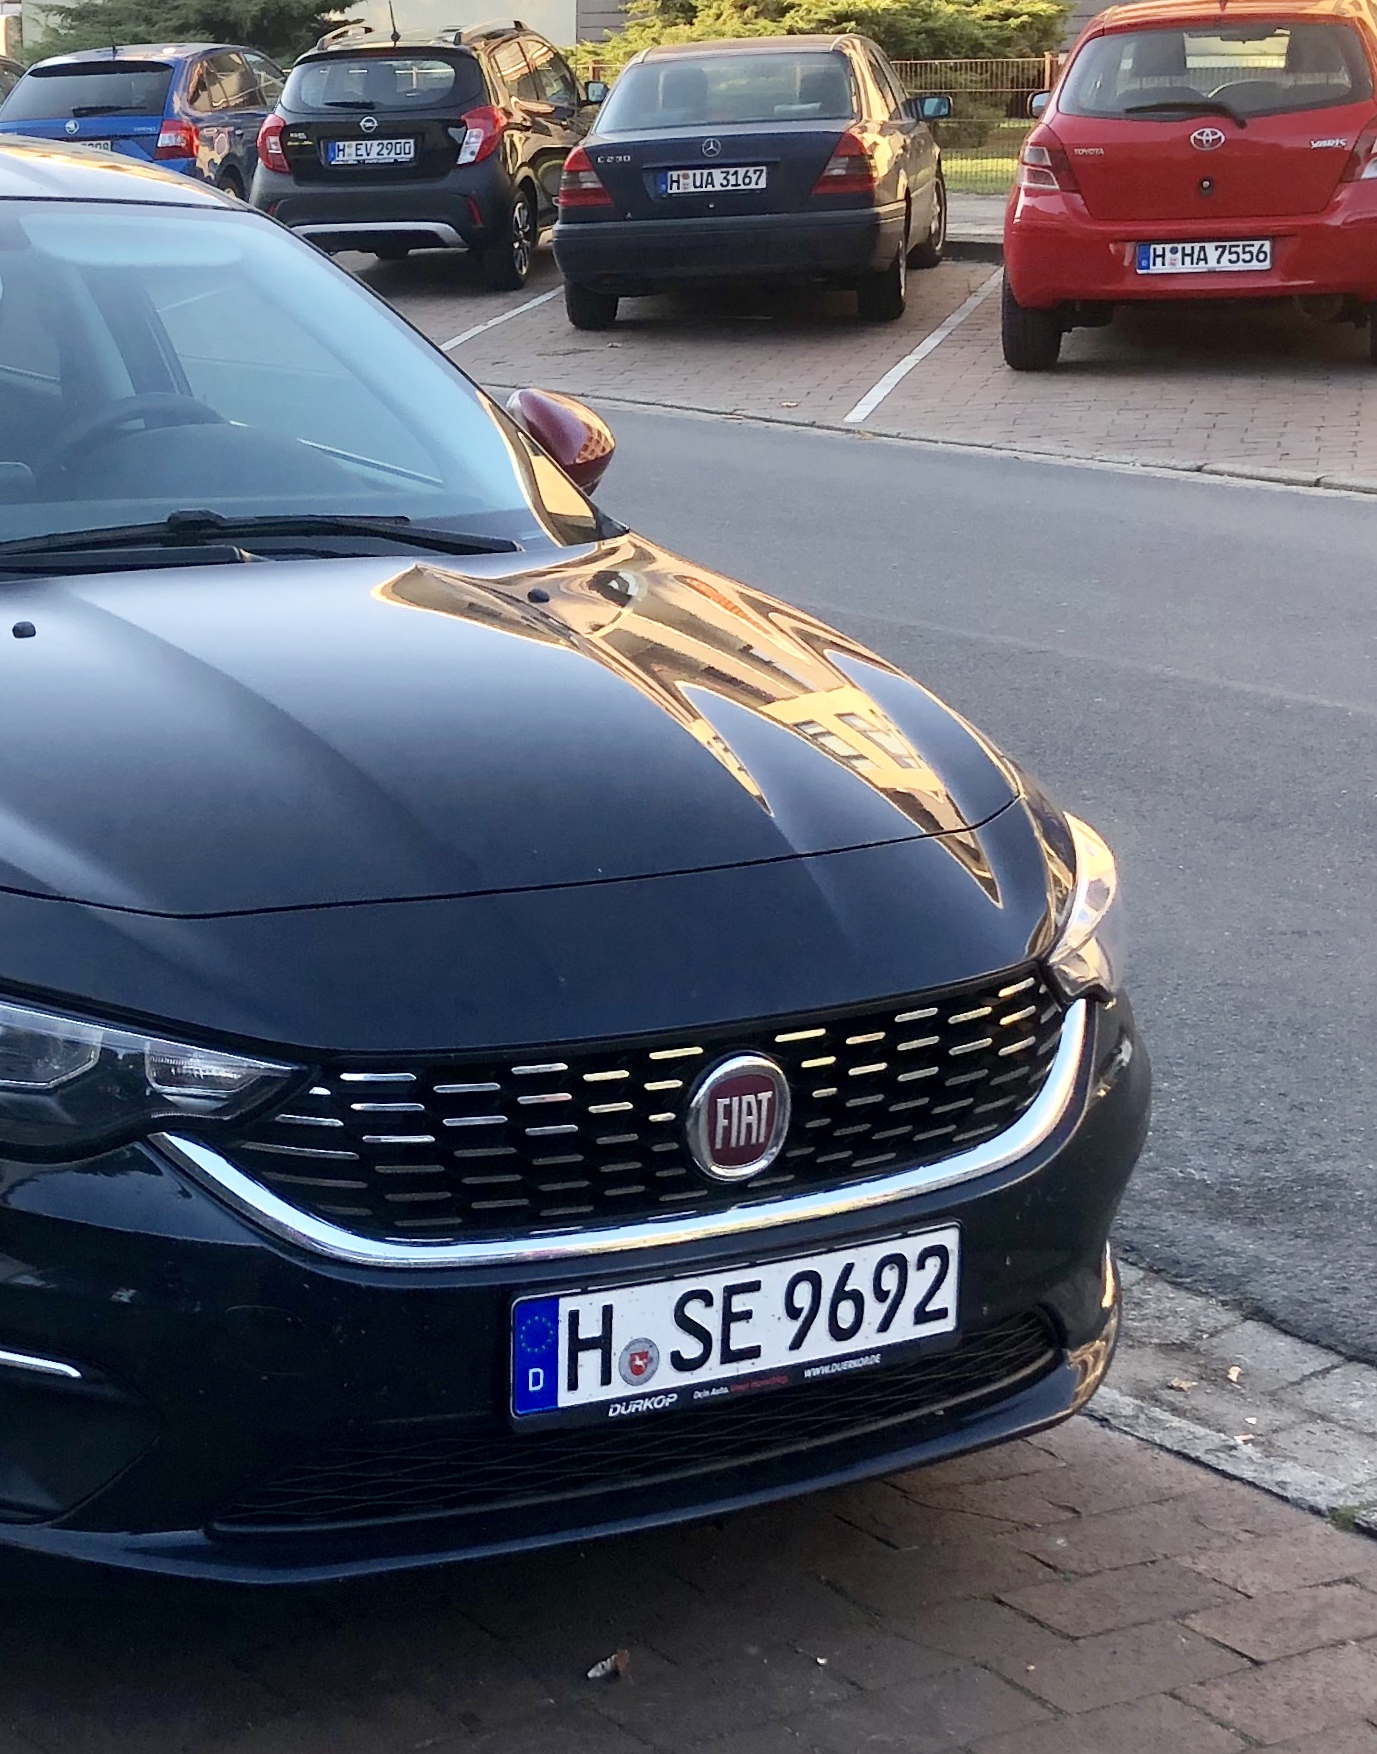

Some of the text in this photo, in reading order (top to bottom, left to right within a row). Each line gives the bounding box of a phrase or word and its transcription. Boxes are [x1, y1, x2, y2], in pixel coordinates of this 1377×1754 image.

[336, 141, 412, 158] H EV 2900
[1073, 147, 1105, 157] TOYOTA
[669, 168, 764, 191] H UA 3167
[1152, 246, 1166, 267] H
[1181, 245, 1209, 266] HA
[1214, 243, 1268, 265] 7556
[714, 1090, 774, 1150] FIAT
[528, 1243, 950, 1392] D H SE 9692
